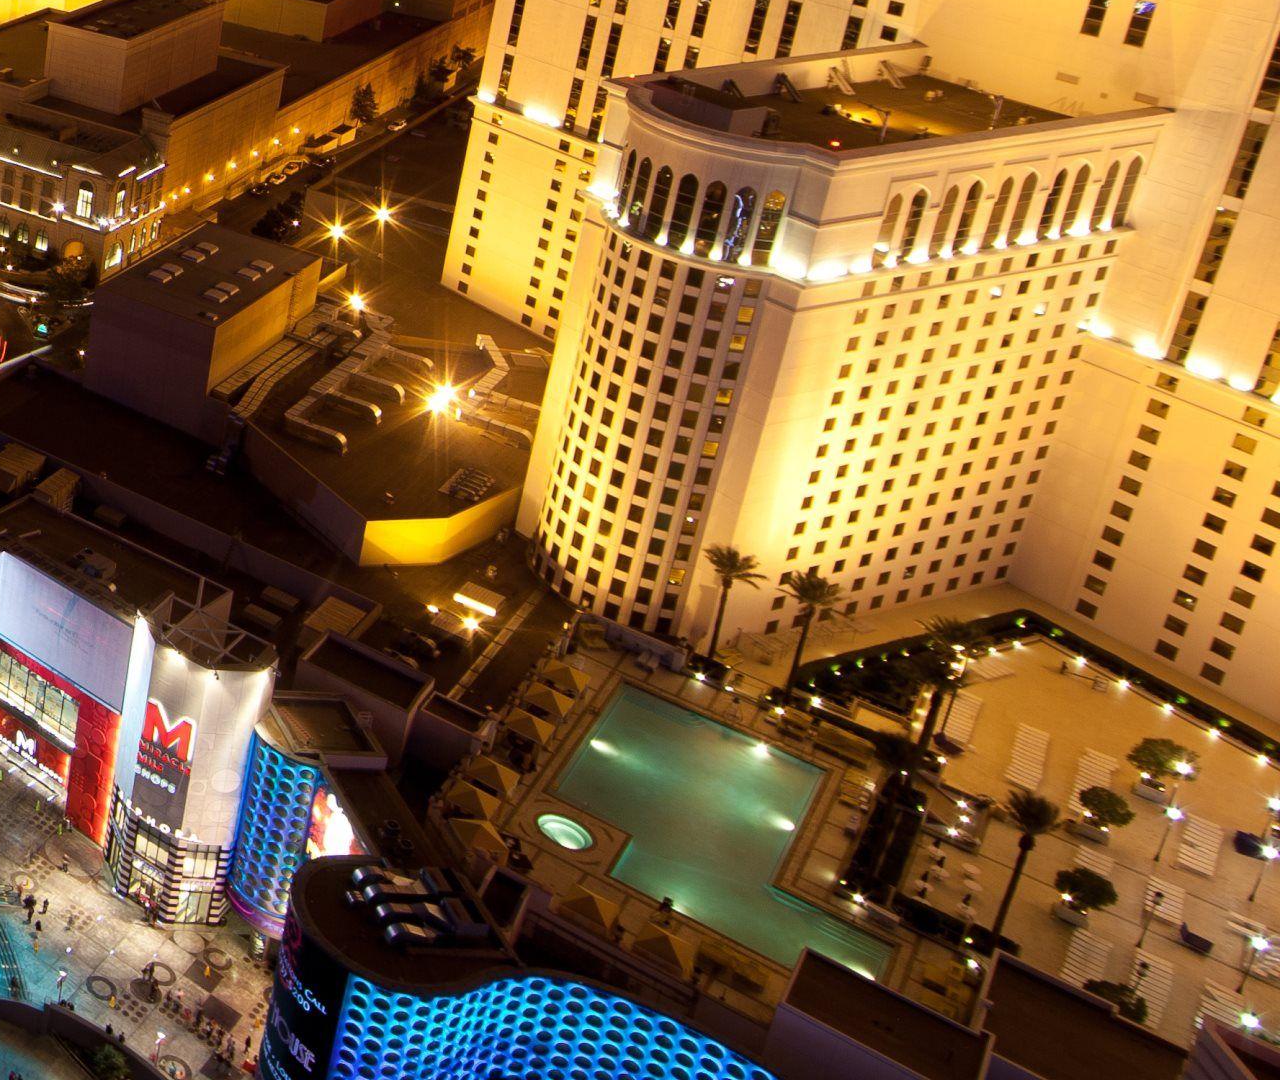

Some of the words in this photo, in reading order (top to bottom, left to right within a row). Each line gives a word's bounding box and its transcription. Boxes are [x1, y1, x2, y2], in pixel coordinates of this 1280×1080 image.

[136, 751, 164, 773] MILE
[138, 738, 191, 777] MIRACLE
[134, 763, 177, 795] SHOPS
